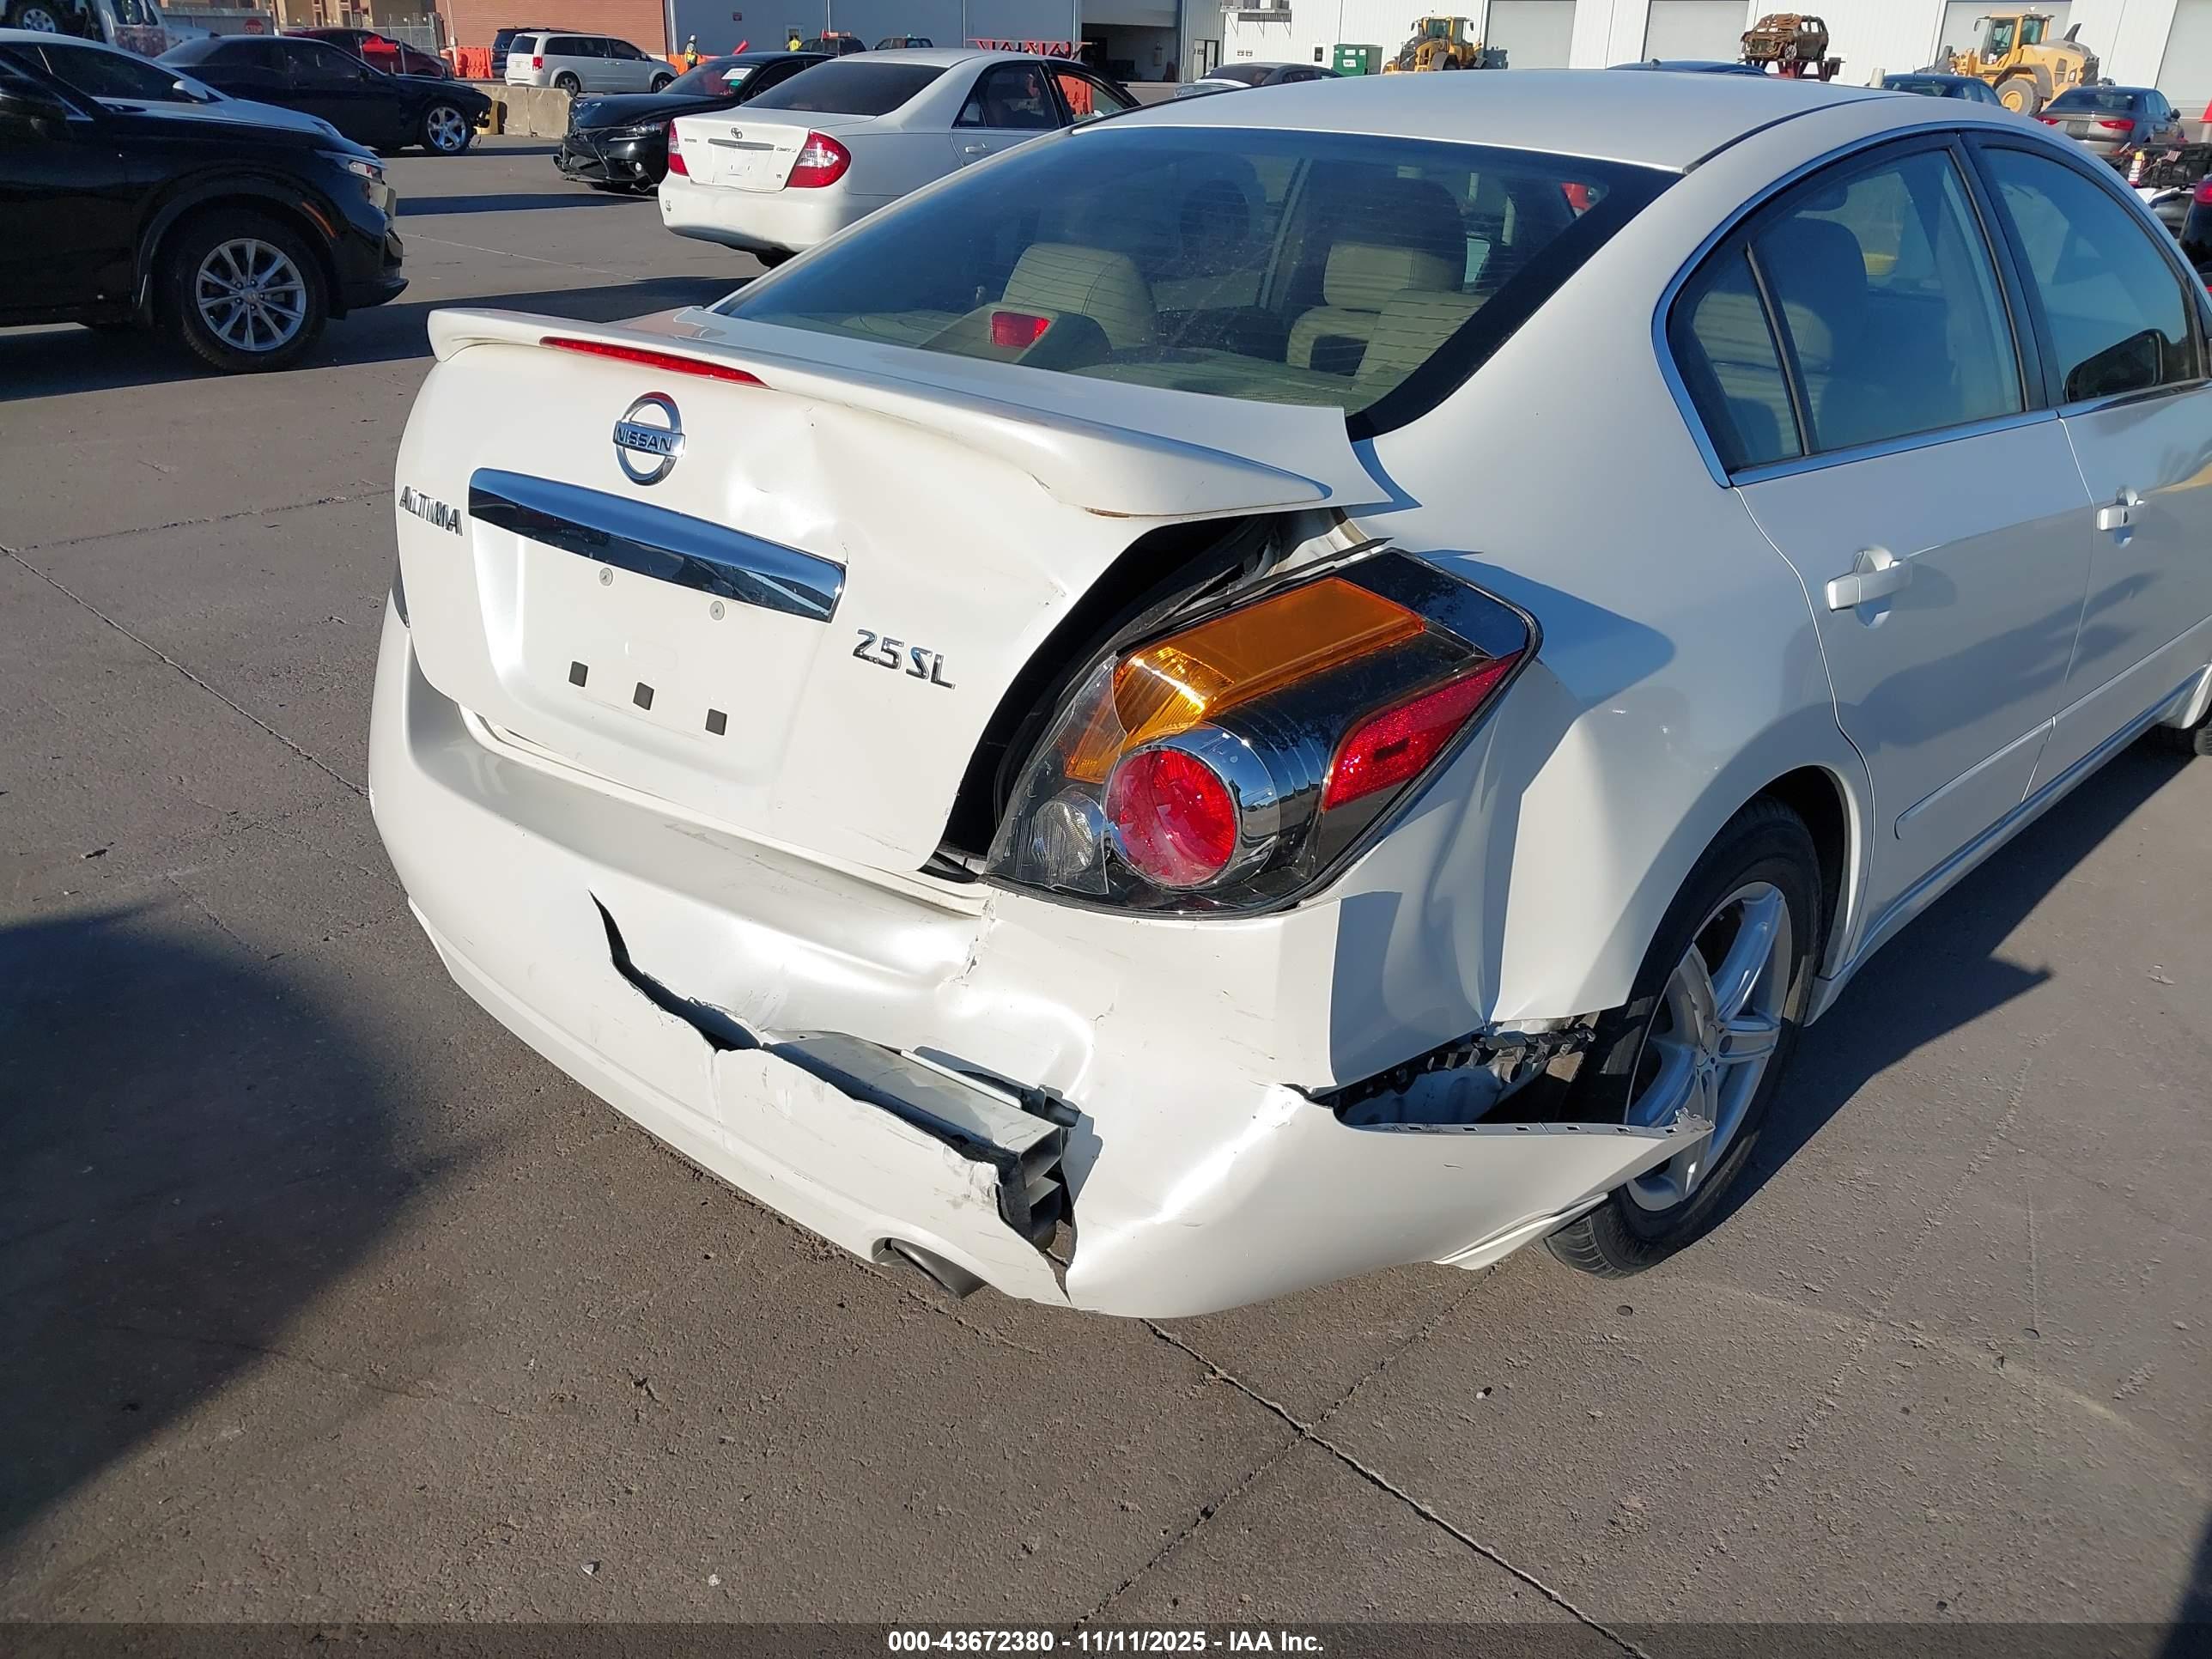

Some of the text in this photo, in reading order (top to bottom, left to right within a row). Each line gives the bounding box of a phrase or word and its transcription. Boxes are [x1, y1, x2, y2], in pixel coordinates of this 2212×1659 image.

[246, 25, 262, 34] STOP
[617, 426, 673, 452] NISSAN
[398, 485, 463, 537] ALTIMA
[905, 646, 957, 690] SL
